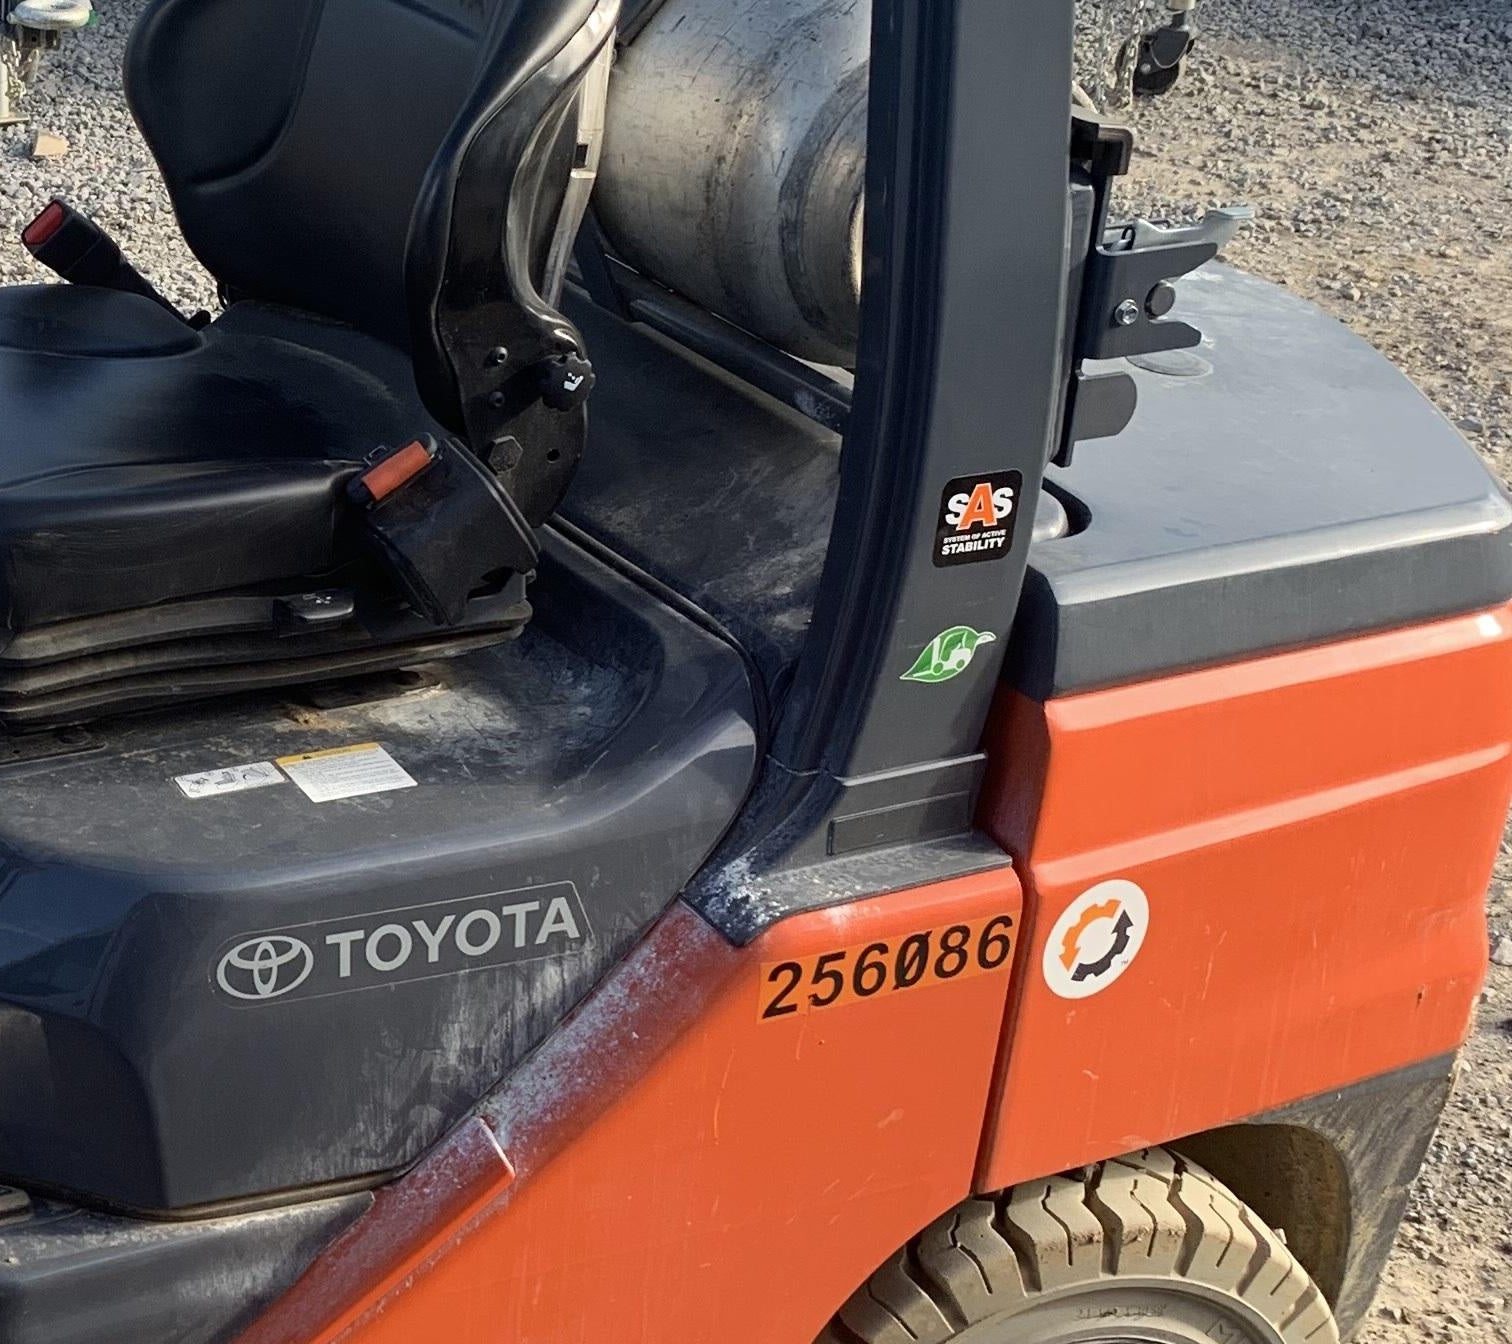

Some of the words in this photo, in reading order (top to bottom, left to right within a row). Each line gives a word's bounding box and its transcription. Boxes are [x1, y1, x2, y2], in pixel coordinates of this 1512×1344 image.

[945, 482, 1014, 531] SAS
[941, 536, 1006, 556] STABILITY
[325, 896, 580, 978] TOYOTA
[761, 914, 1014, 1020] 256086
